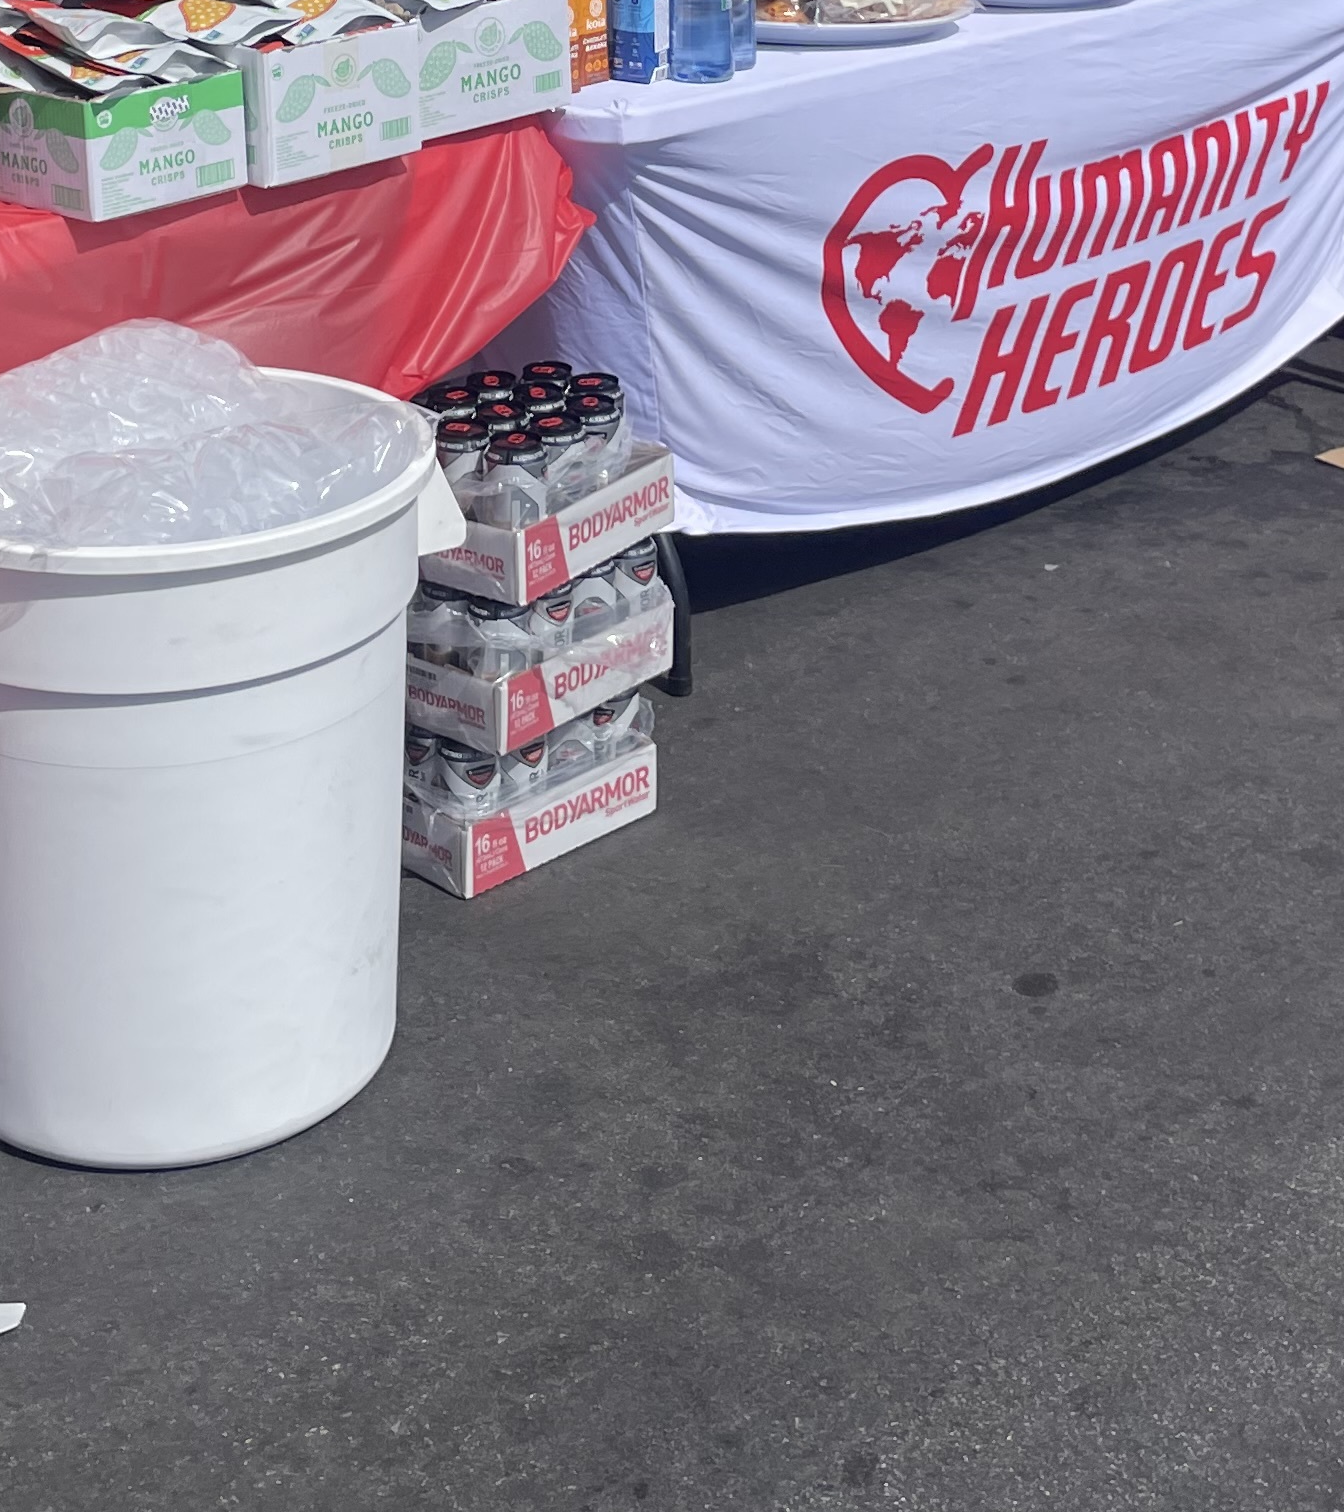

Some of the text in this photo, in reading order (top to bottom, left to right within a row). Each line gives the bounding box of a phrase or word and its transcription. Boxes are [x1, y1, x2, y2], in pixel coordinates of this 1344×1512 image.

[460, 63, 522, 93] MANGO
[473, 86, 510, 104] CRISPS
[317, 111, 374, 139] MANGO
[328, 133, 363, 150] CRISPS
[0, 151, 48, 175] MANGO
[139, 149, 196, 176] MANGO
[11, 173, 40, 187] CRISPS
[151, 170, 185, 186] CRISPS
[951, 81, 1331, 322] HUMANITY
[952, 197, 1290, 438] HEROES
[568, 475, 670, 551] BODYARMOR
[527, 538, 542, 561] 16
[409, 686, 486, 725] BODYARMOR
[510, 689, 524, 711] 16
[524, 765, 650, 844] BODYARMOR
[475, 833, 491, 856] 16
